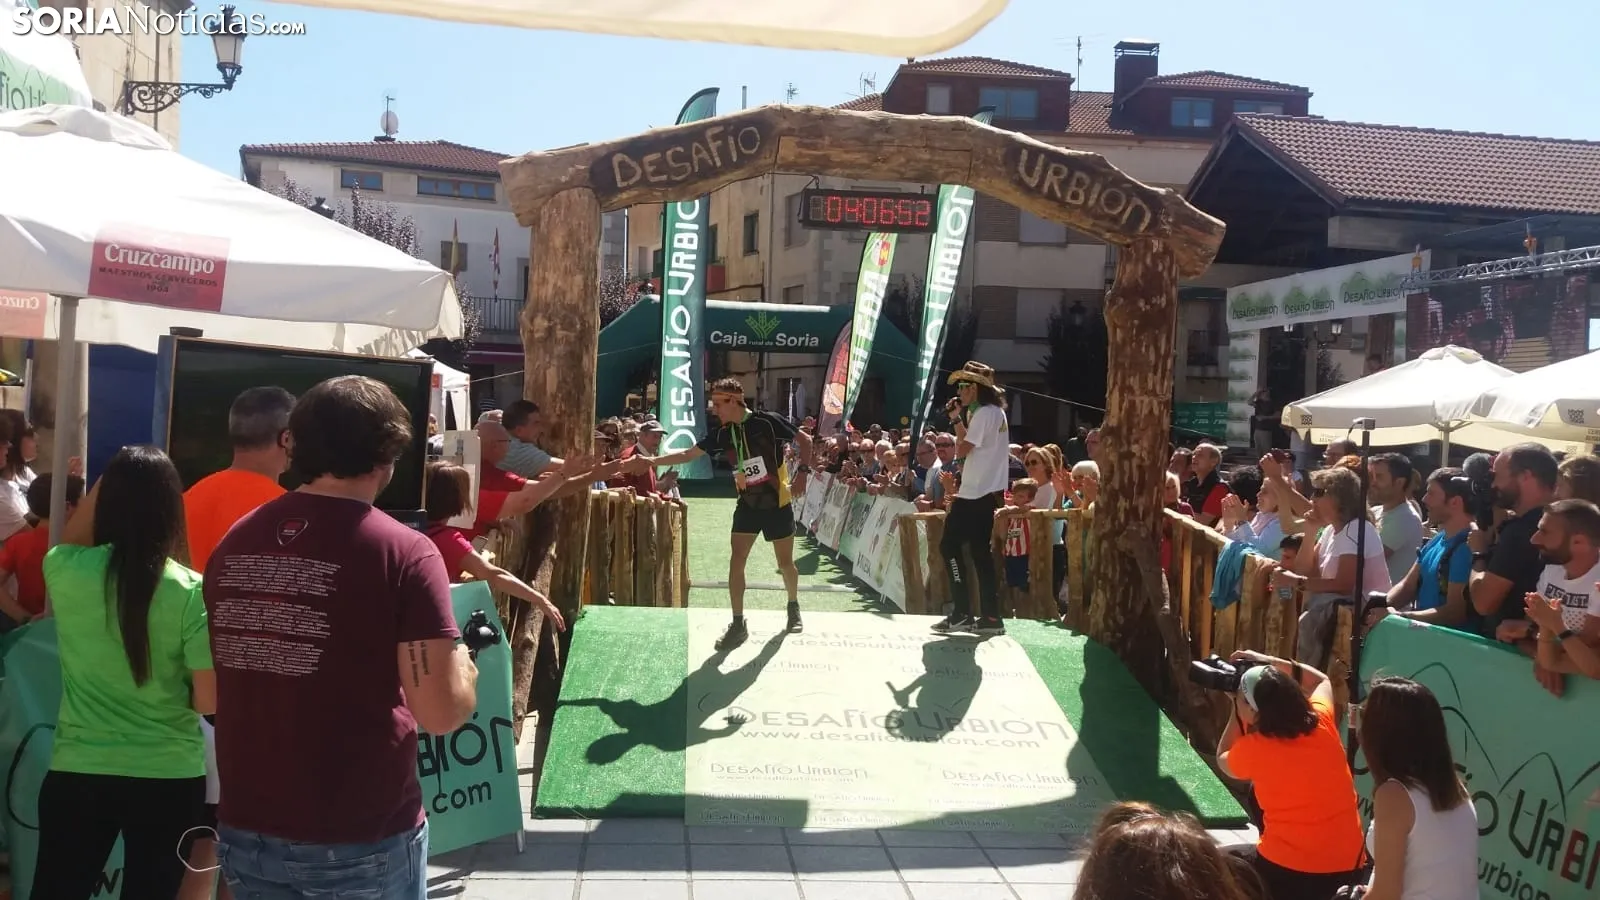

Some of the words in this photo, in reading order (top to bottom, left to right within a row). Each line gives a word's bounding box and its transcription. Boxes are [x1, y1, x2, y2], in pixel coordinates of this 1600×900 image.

[104, 243, 215, 275] Cruzcampo
[99, 266, 152, 280] MAESTROS
[154, 272, 218, 287] CERVECEROS
[710, 330, 747, 347] Caja
[776, 332, 819, 347] Soria
[743, 465, 760, 477] 38
[1508, 788, 1600, 890] URBI
